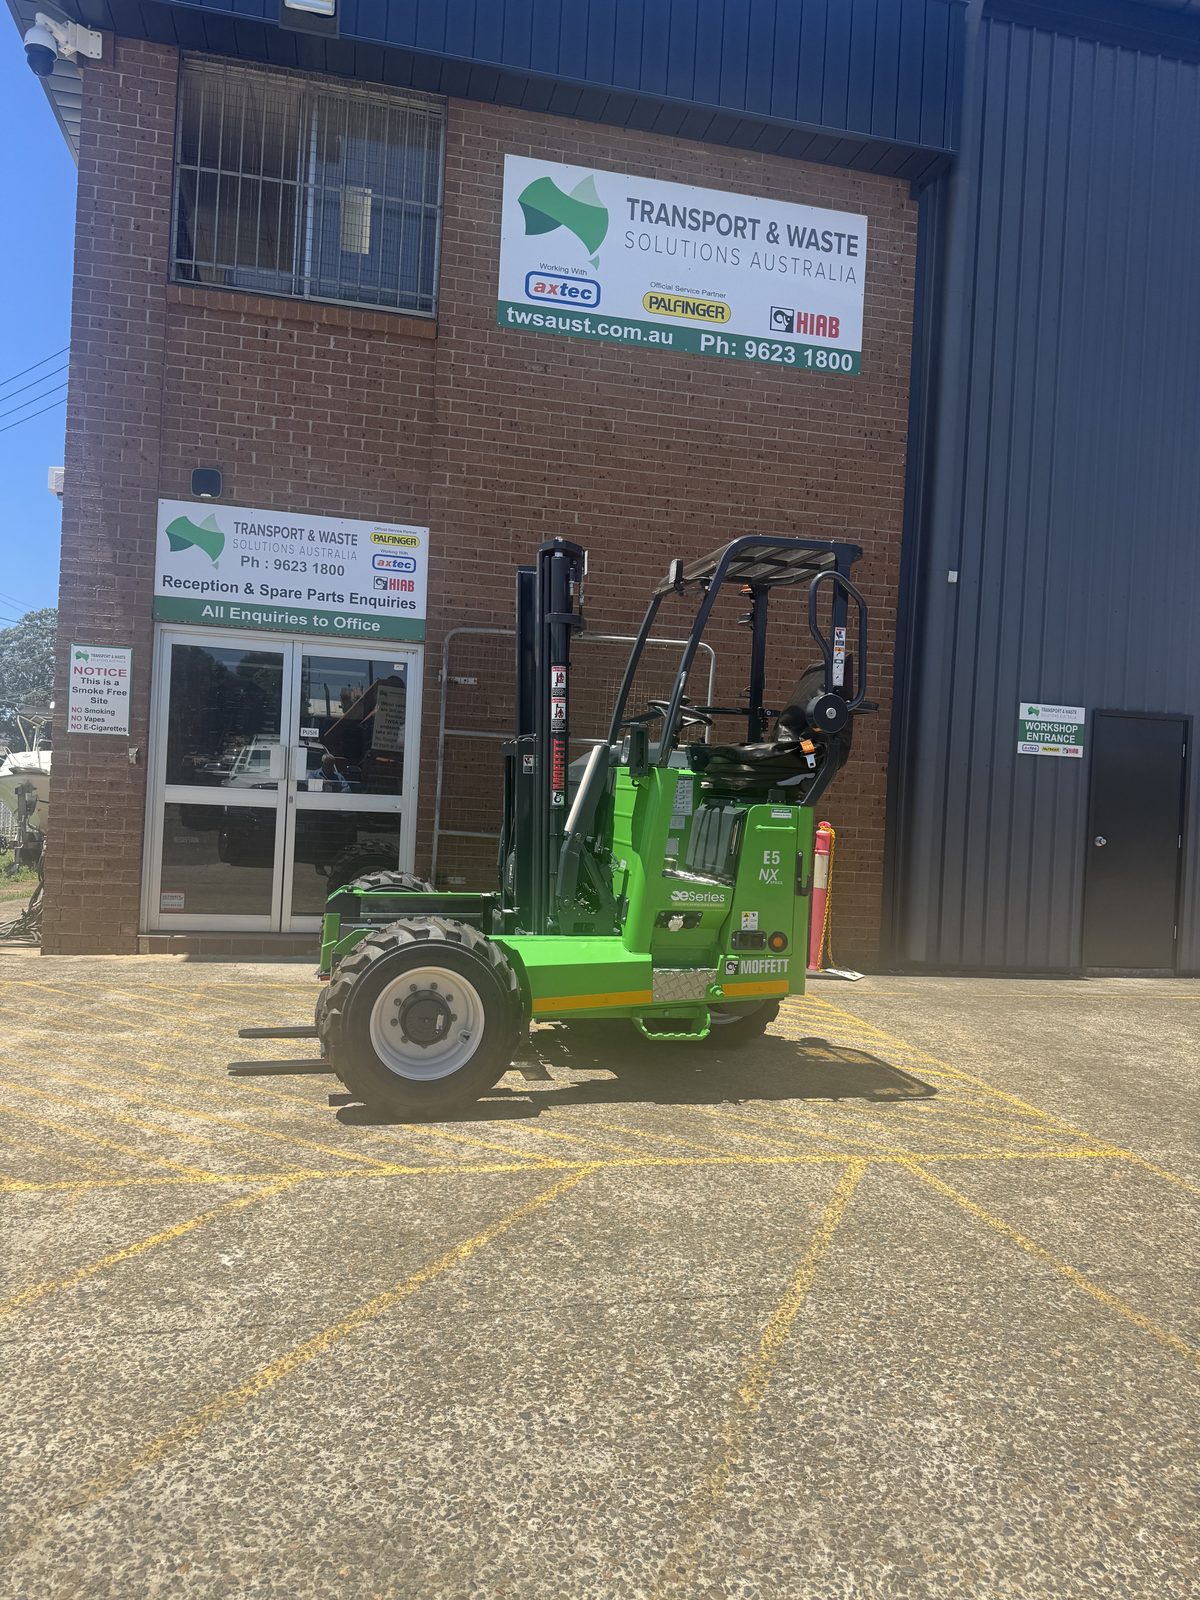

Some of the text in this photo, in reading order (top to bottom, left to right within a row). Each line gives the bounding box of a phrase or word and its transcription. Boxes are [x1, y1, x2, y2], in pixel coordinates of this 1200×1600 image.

[626, 197, 859, 258] TRANSPORT & WASTE
[624, 230, 857, 285] SOLUTIONS AUSTRALIA
[539, 262, 588, 276] Working With
[533, 279, 593, 301] axtec
[650, 281, 727, 299] Official Service Partner
[649, 294, 725, 320] PALFINGER
[796, 311, 840, 339] HIAB
[506, 306, 853, 372] twsaust.com.au Ph: 9623 1800
[233, 521, 358, 546] TRANSPORT & WASTE
[373, 534, 417, 546] PALFINGER
[232, 538, 357, 561] SOLUTIONS AUSTRALIA
[240, 555, 260, 569] Ph
[273, 559, 308, 573] 9623
[312, 563, 345, 577] 1800
[377, 559, 412, 569] axtec
[162, 574, 417, 610] Reception & Spare Parts Enquiries
[389, 577, 415, 593] HIAB
[201, 604, 381, 632] All Enquiries to Office
[73, 666, 127, 678] NOTICE
[81, 677, 100, 685] This
[103, 678, 112, 686] is
[72, 686, 127, 696] Smoke Free
[90, 697, 108, 705] Site
[84, 707, 116, 716] Smoking
[84, 724, 127, 732] E-Cigarettes
[1025, 721, 1078, 734] WORKSHOP
[1026, 732, 1076, 744] ENTRANCE
[552, 738, 566, 790] MOFFETT
[763, 850, 780, 865] E5
[759, 868, 779, 884] NX
[740, 959, 789, 974] MOFFETT
